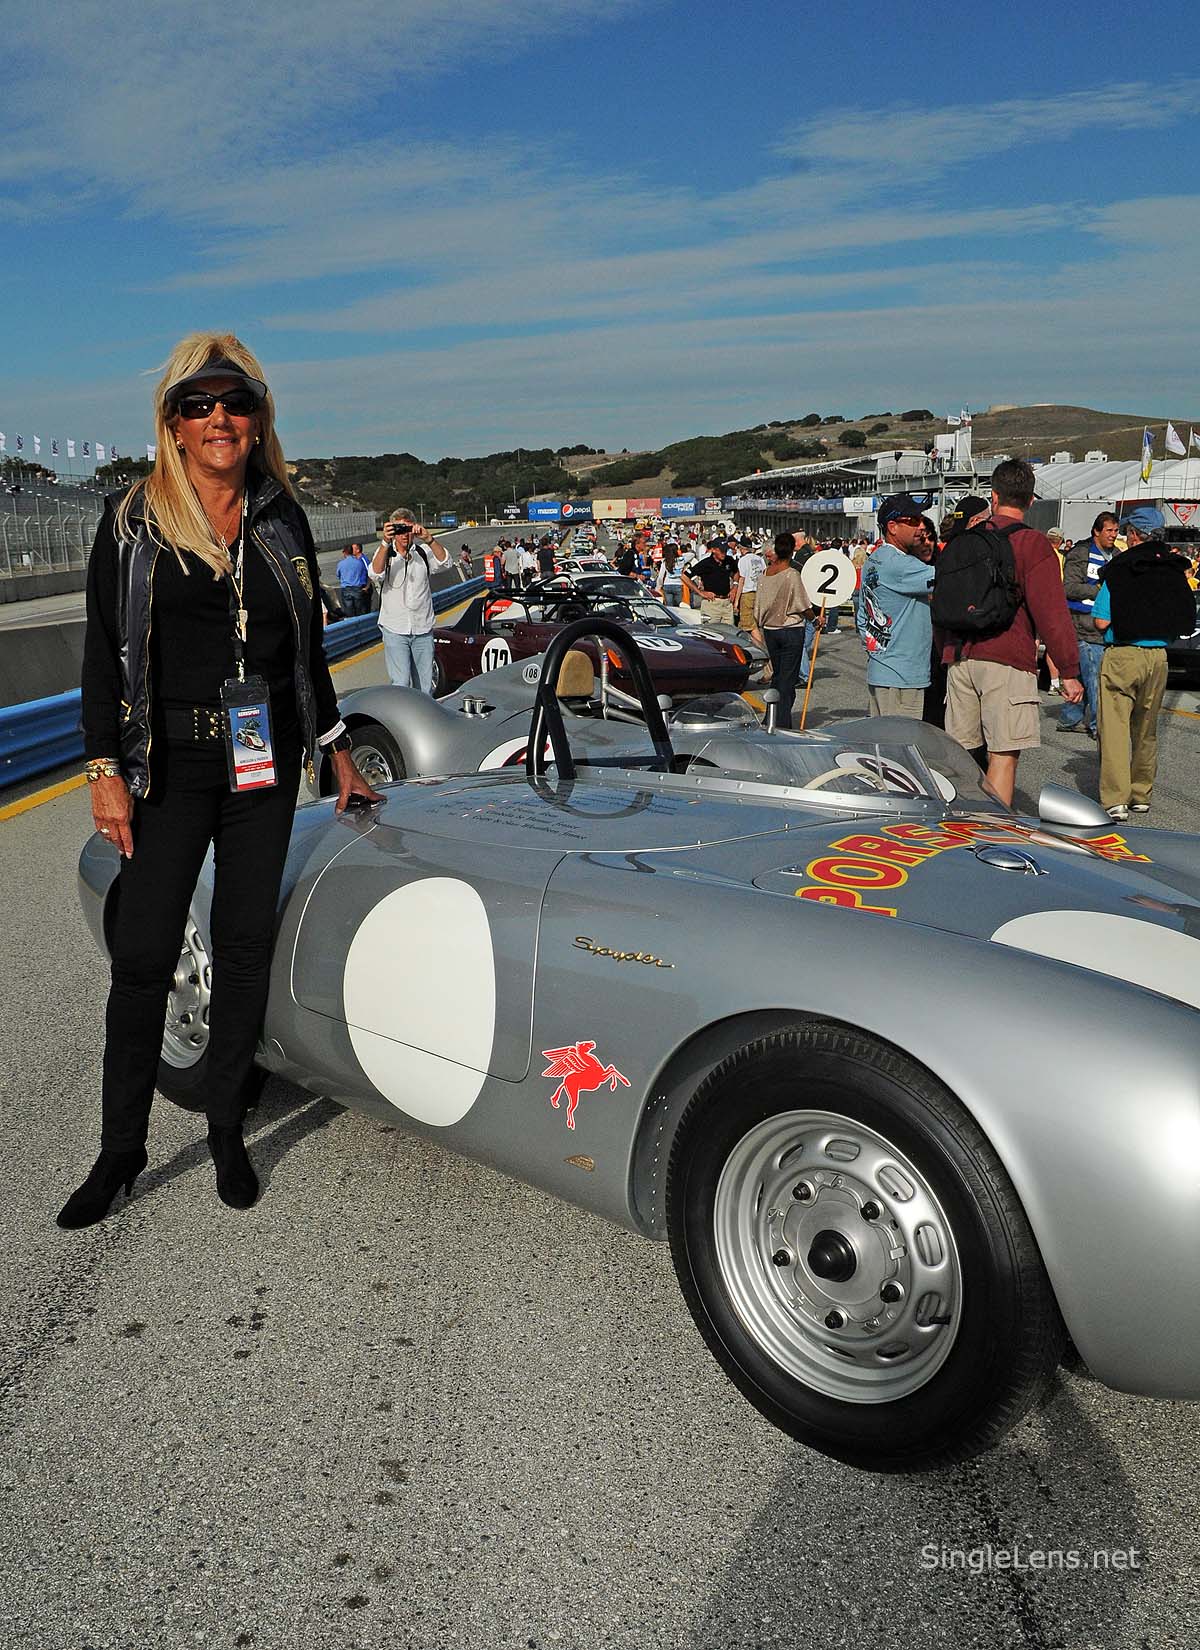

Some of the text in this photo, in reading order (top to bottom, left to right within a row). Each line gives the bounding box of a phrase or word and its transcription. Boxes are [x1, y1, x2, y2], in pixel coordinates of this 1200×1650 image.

[573, 506, 591, 515] pepsi
[817, 564, 839, 595] 2
[525, 668, 538, 679] 108
[572, 936, 676, 968] Spyder
